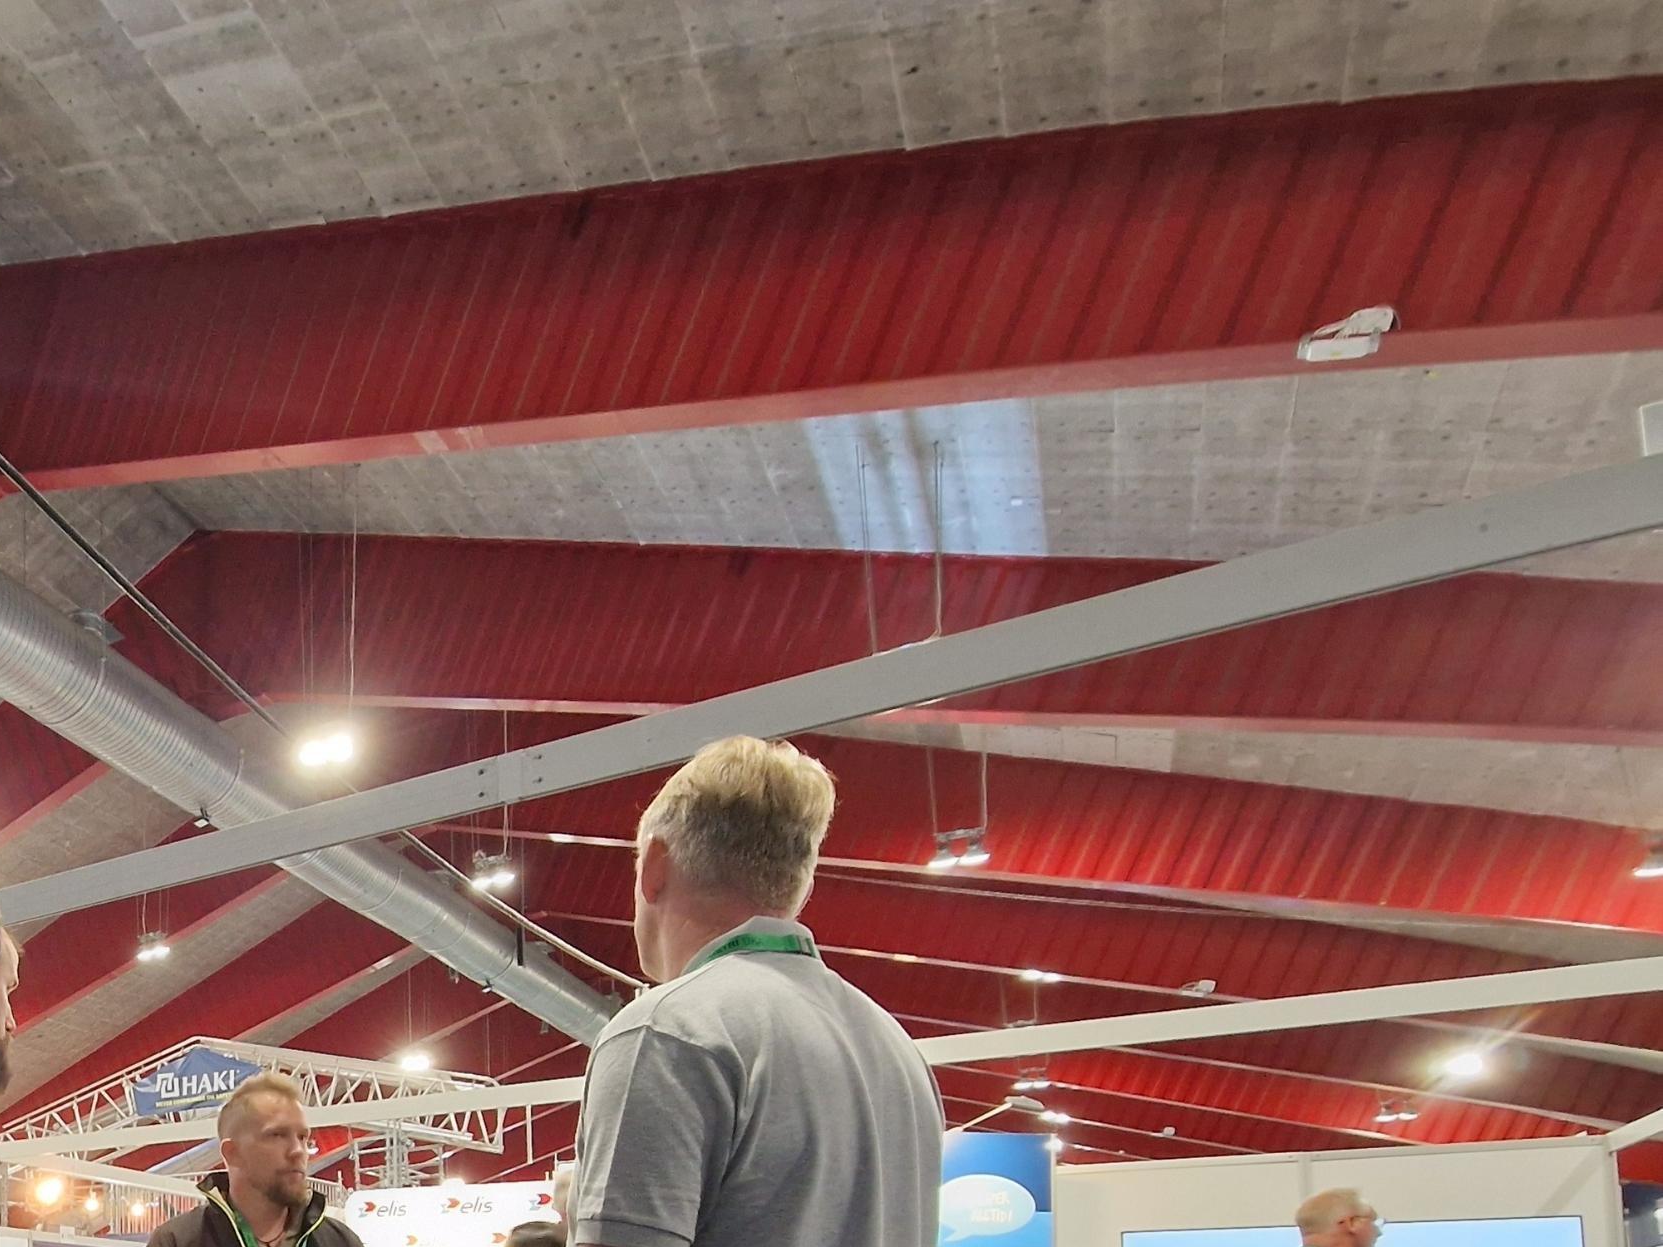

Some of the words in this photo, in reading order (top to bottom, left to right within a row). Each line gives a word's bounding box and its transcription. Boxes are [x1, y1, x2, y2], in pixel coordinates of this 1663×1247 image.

[182, 1070, 235, 1096] HAKI
[377, 1200, 407, 1217] elis
[460, 1196, 493, 1214] elis
